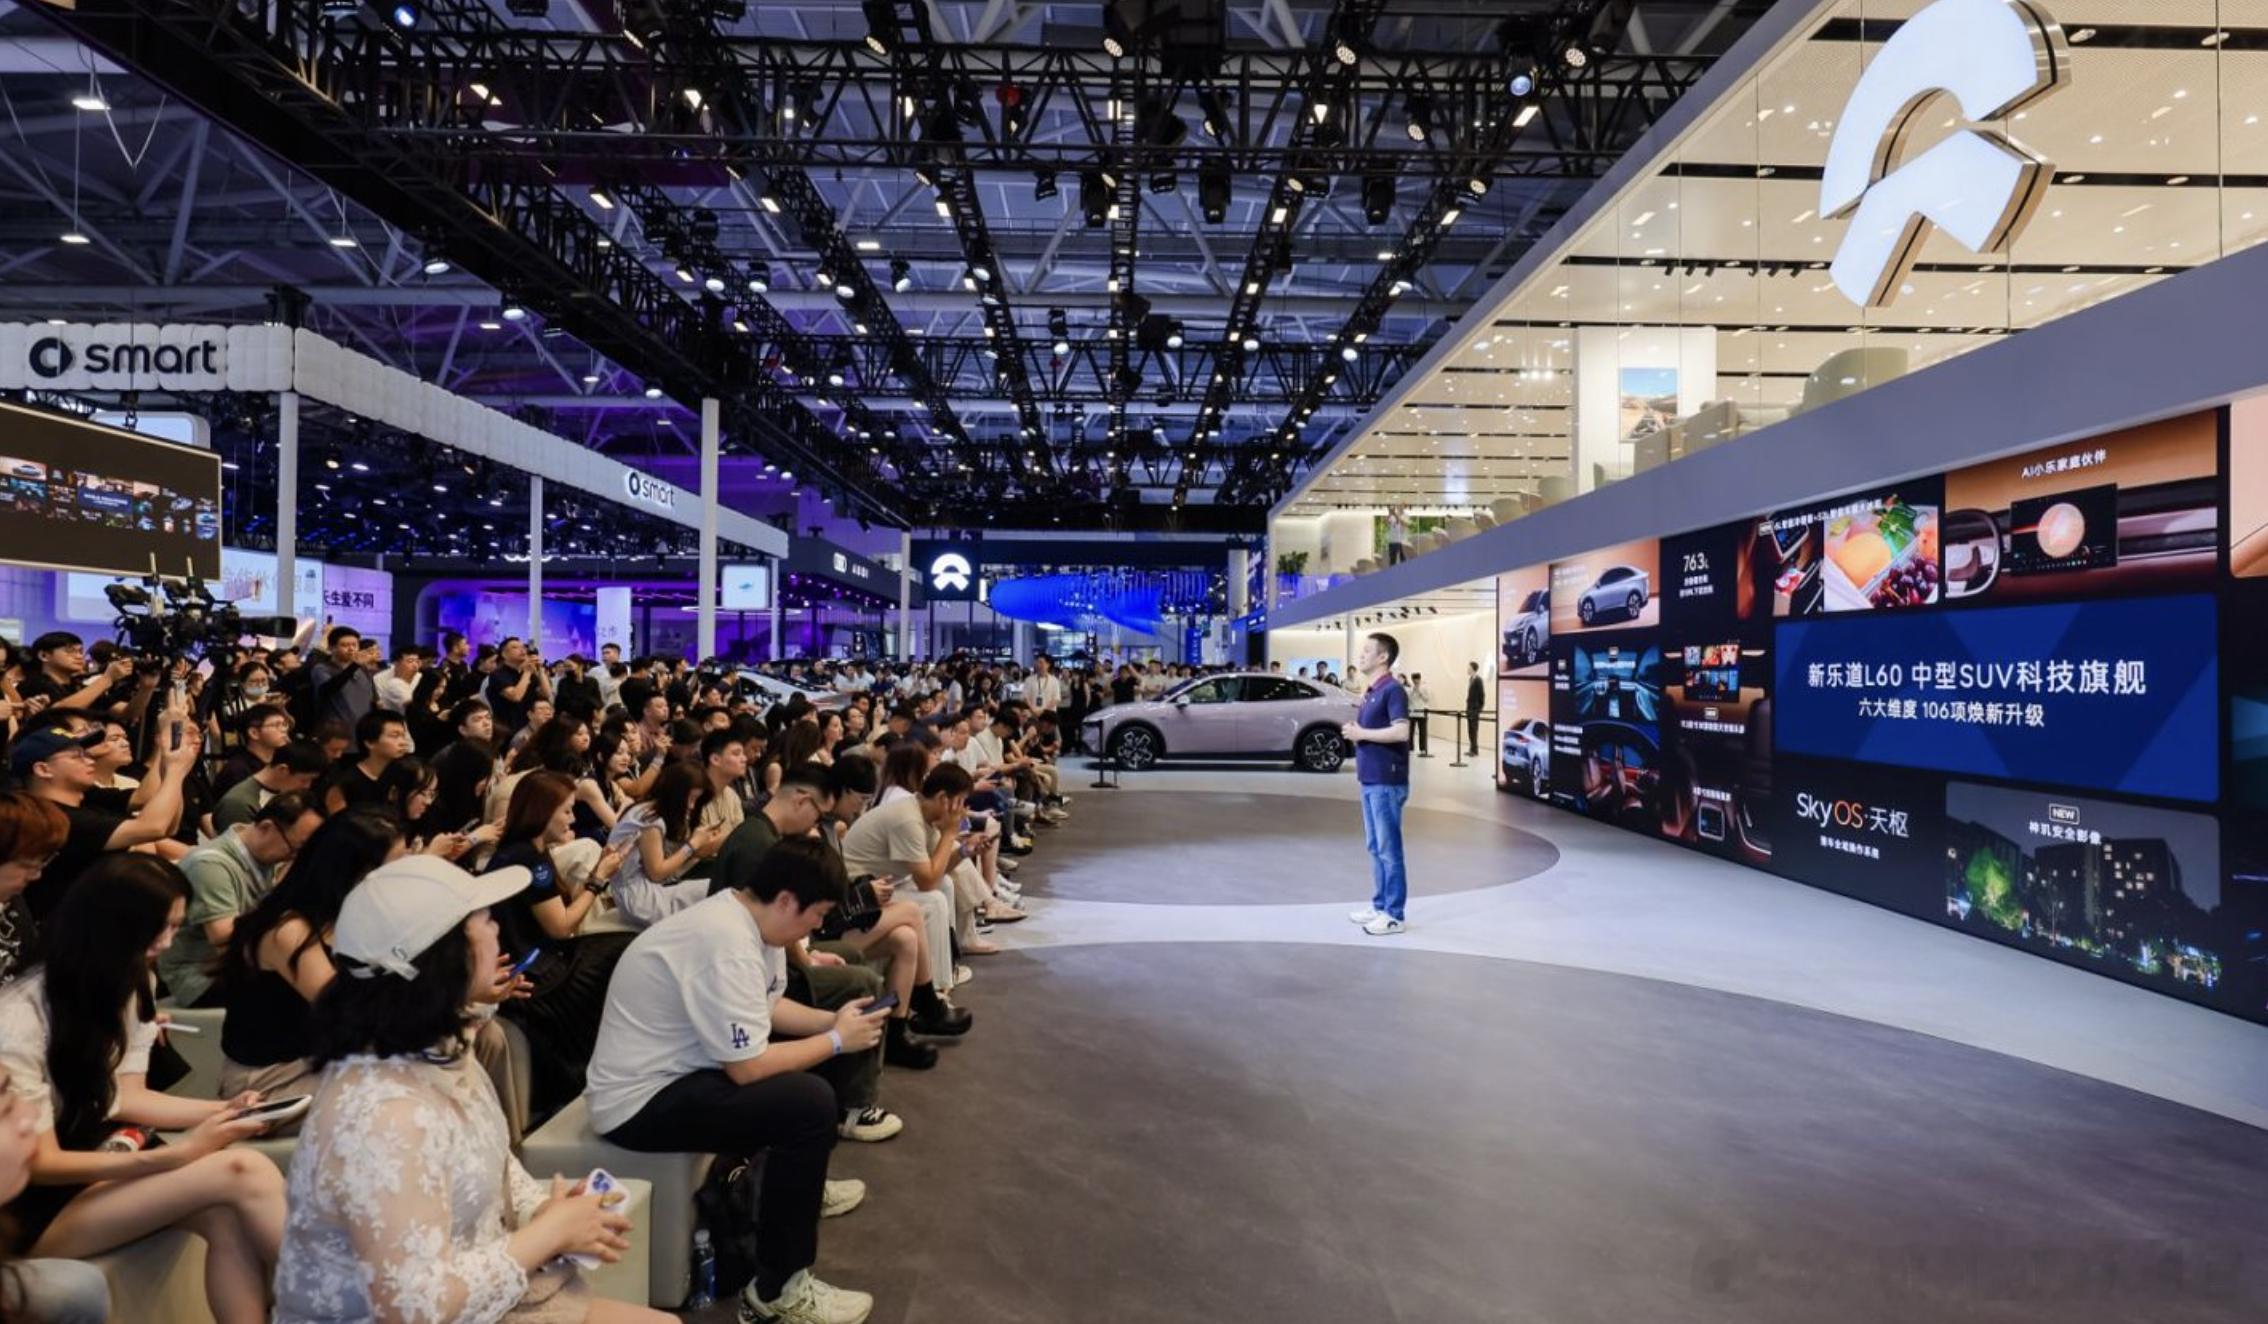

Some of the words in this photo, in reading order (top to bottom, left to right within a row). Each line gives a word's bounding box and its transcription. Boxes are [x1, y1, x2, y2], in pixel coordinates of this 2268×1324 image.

[83, 340, 217, 375] smart
[2021, 448, 2107, 479] AI小乐家庭伙伴
[643, 480, 675, 507] smart
[1808, 661, 1902, 688] 新乐道L60
[1912, 659, 2146, 695] 中型SUV科技旗舰
[1858, 698, 1917, 720] 六大维度
[1923, 702, 2044, 727] 106项焕新升级
[2052, 807, 2076, 820] NEW
[730, 1023, 750, 1049] LA
